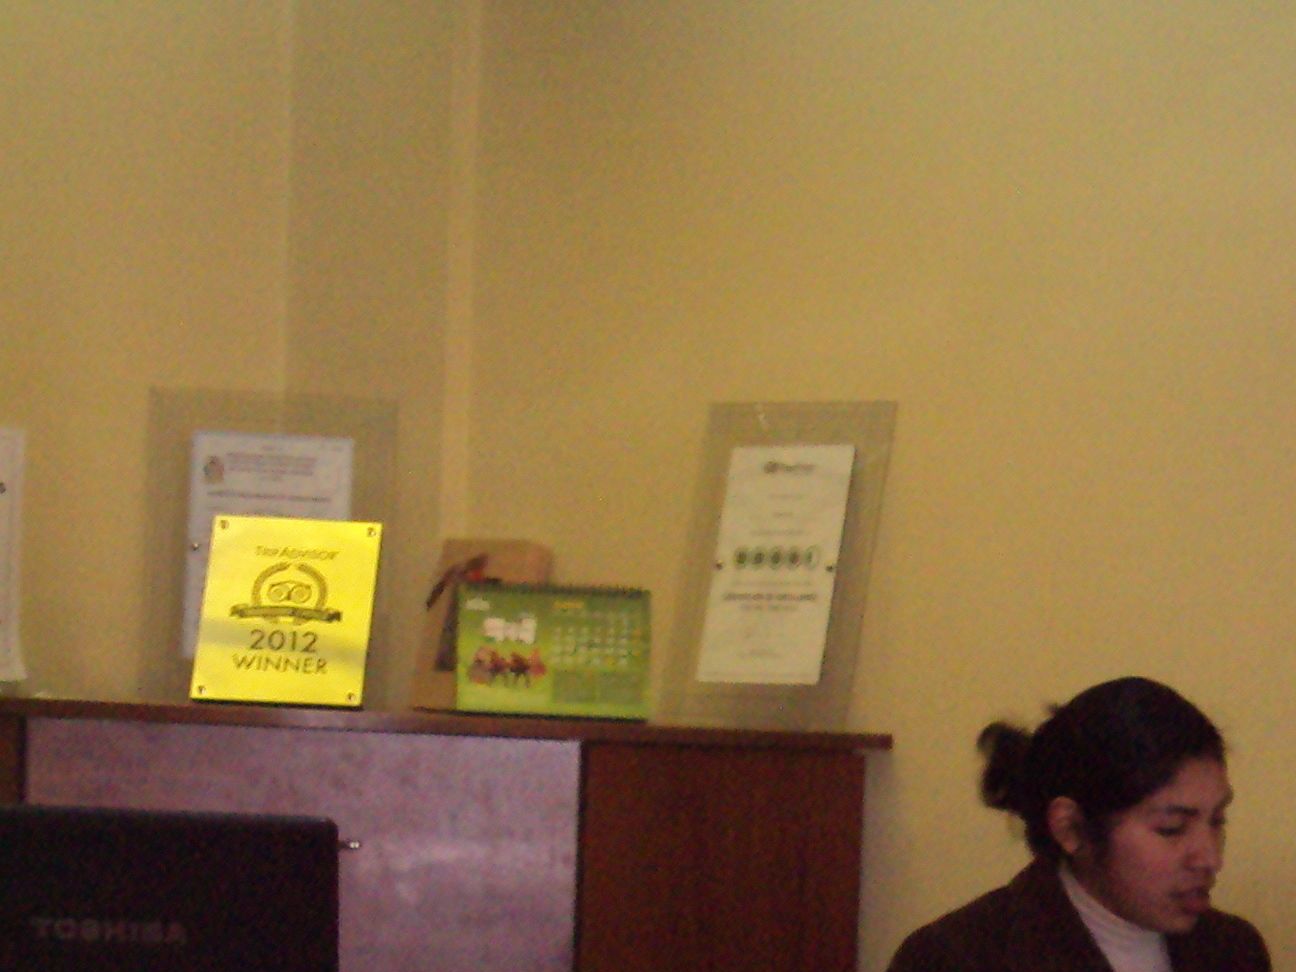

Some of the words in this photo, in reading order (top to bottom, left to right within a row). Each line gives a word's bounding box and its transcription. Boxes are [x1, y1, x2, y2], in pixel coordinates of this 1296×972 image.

[249, 628, 318, 653] 2012
[232, 653, 328, 674] WINNER
[29, 917, 187, 944] TOSHIBA
